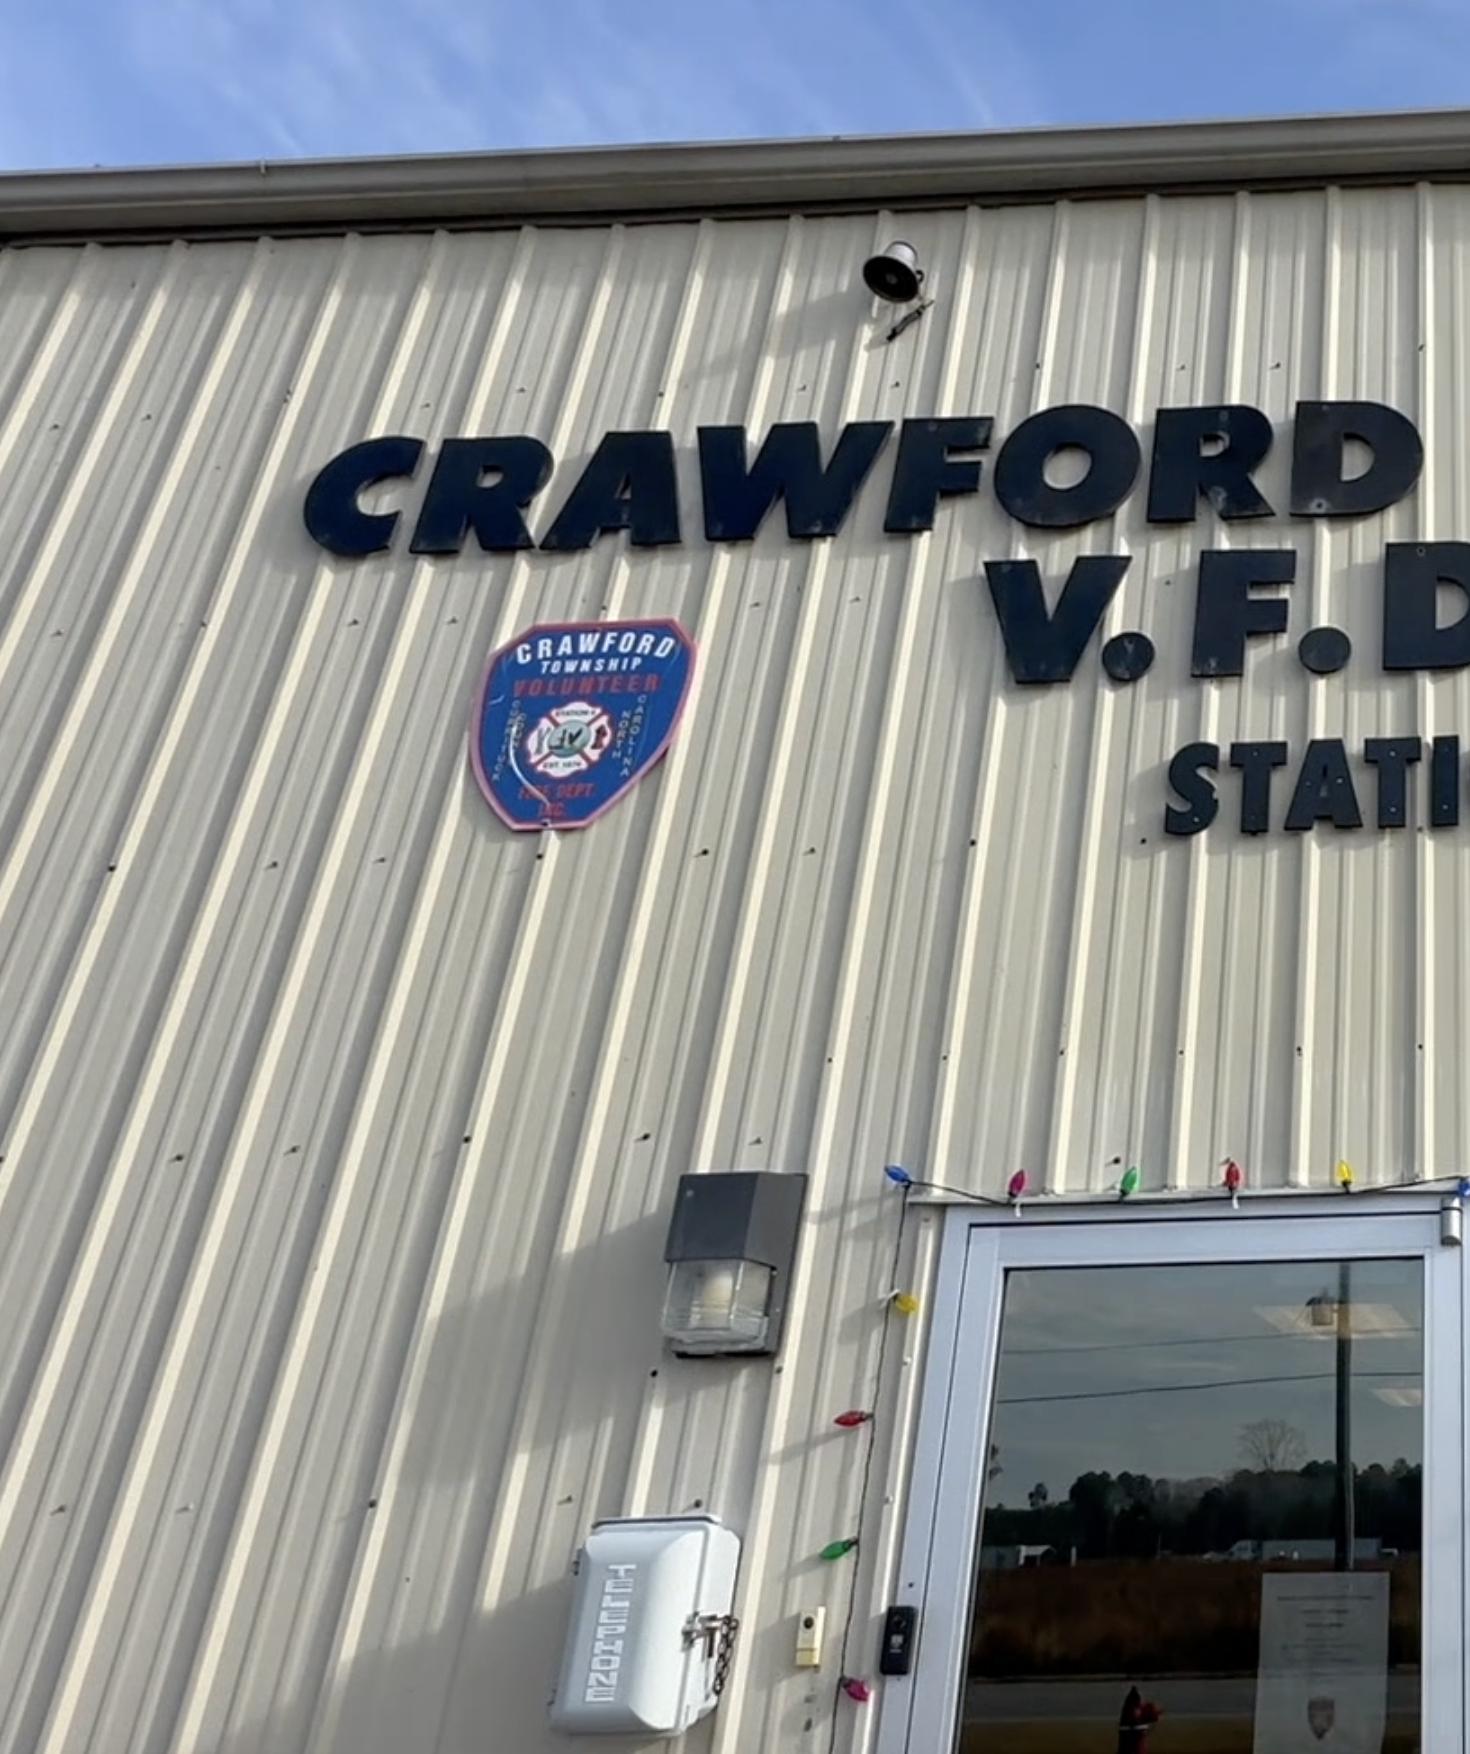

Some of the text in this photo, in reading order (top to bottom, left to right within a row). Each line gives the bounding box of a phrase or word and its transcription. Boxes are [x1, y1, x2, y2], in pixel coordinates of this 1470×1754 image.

[303, 400, 1423, 557] CRAWFORD
[516, 631, 676, 664] CRAWFORD
[541, 656, 643, 674] TOWNSHIP
[513, 673, 661, 698] VOLUNTEER
[612, 709, 631, 759] NORTH
[620, 694, 647, 777] CAROLINA
[585, 1564, 637, 1703] TELEPHONE
